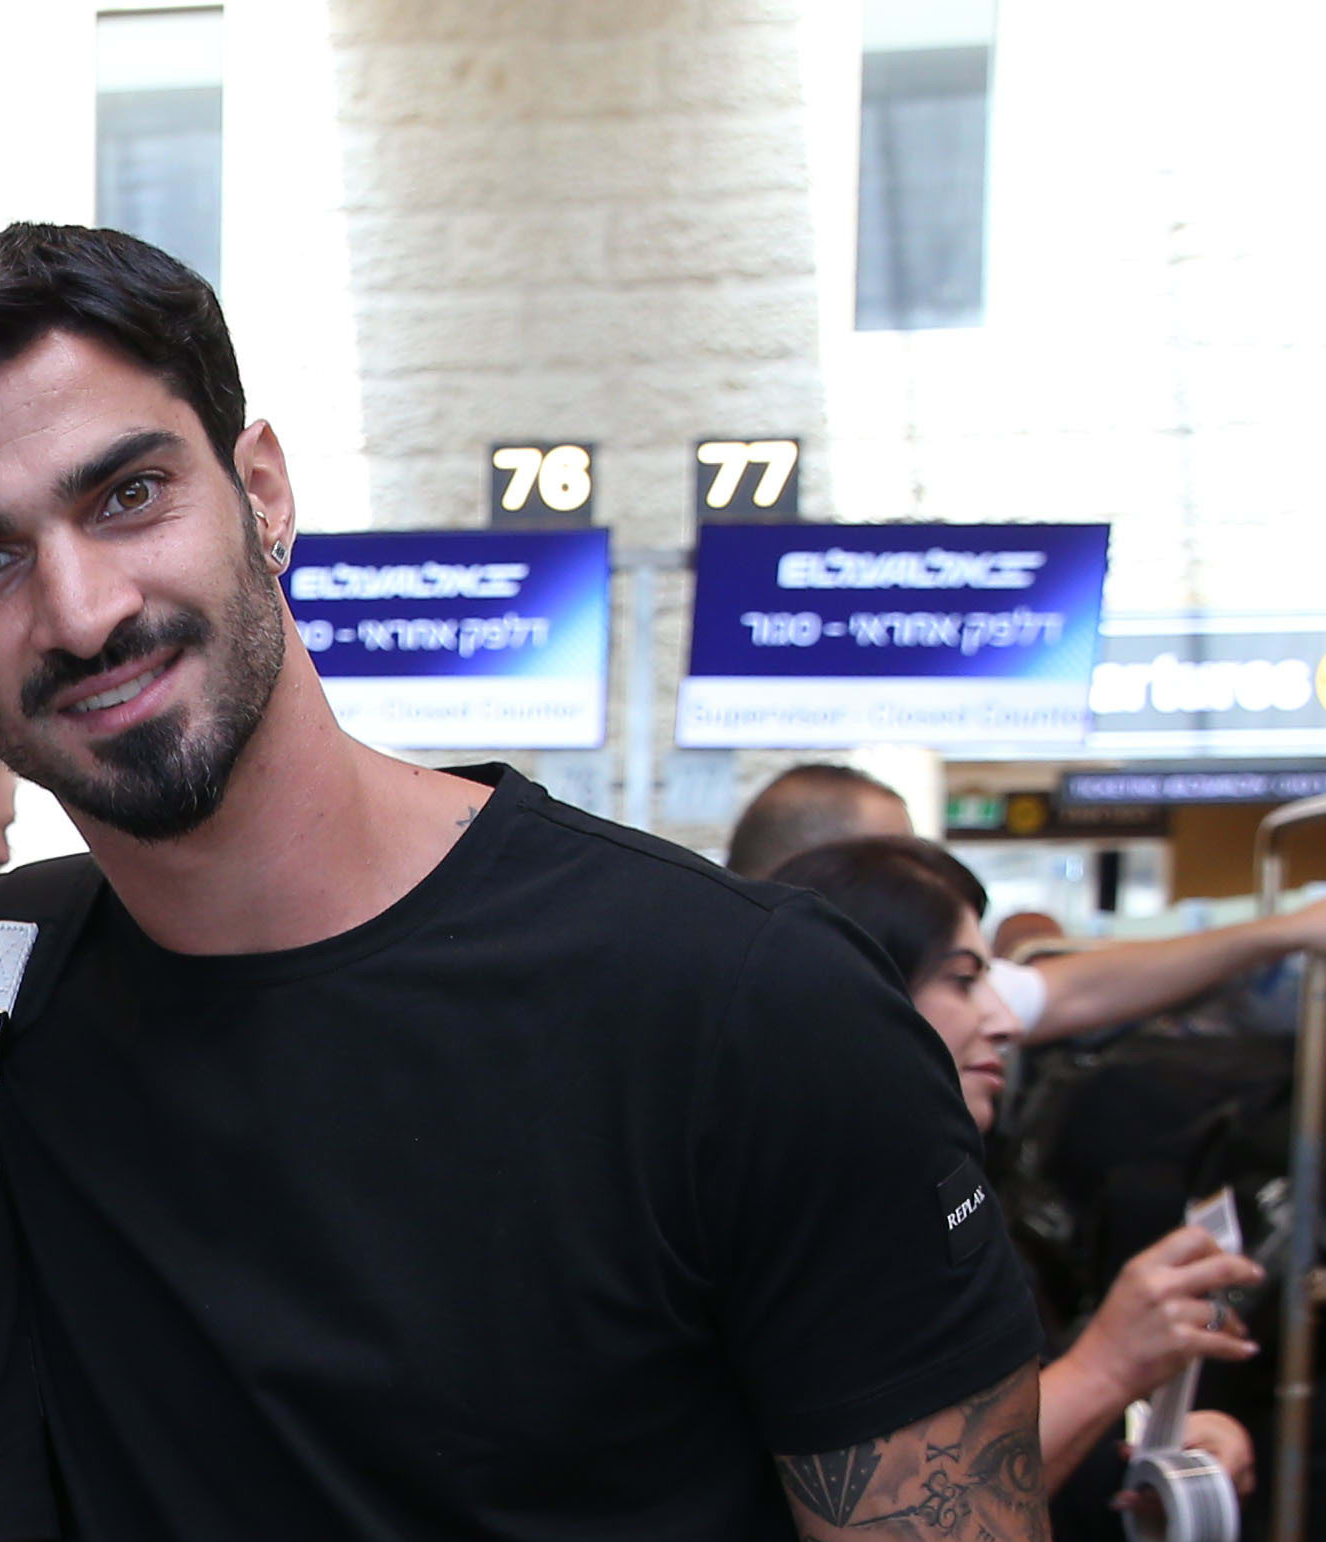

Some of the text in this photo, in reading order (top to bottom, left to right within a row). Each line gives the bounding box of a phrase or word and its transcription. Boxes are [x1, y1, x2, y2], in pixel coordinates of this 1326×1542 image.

[493, 445, 591, 511] 76
[697, 440, 798, 508] 77
[959, 605, 1064, 656] דלפק
[947, 1185, 985, 1230] REPLAY
